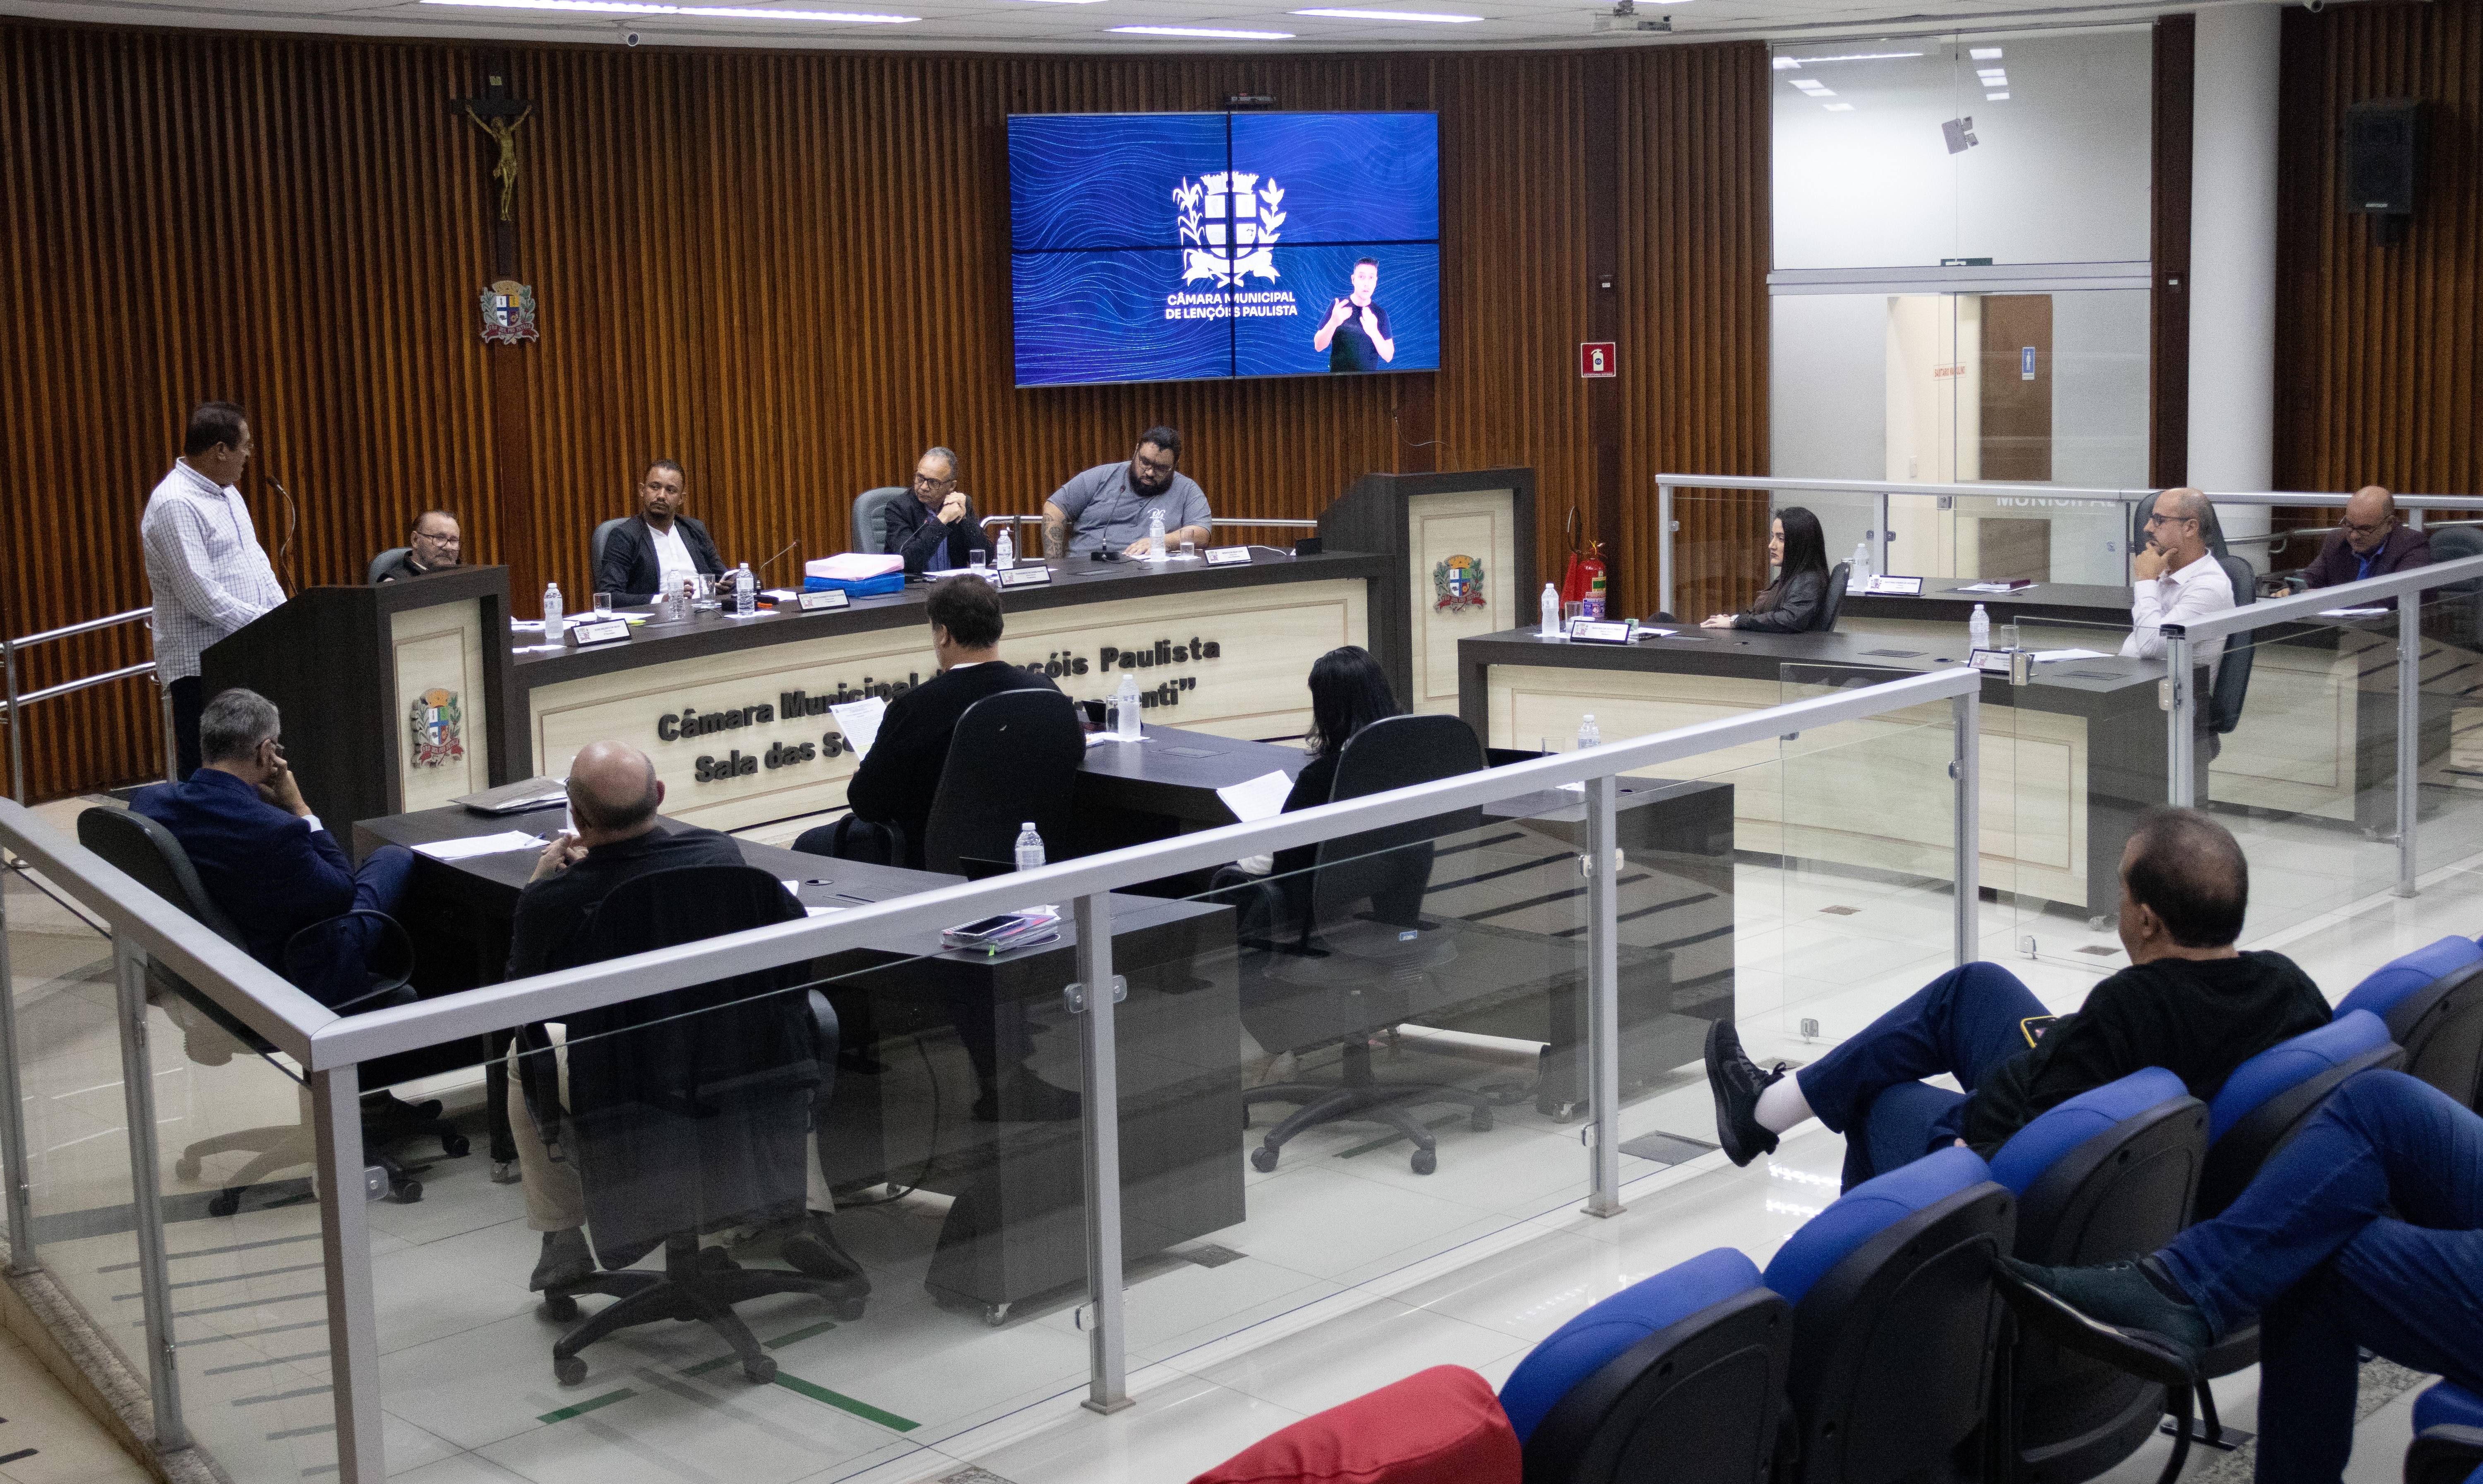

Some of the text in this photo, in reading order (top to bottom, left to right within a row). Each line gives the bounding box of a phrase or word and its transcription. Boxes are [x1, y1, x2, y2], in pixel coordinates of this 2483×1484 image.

[1167, 291, 1295, 305] CÂMARA MUNICIPAL
[1165, 305, 1298, 321] DE LENÇÓIS PAULISTA
[658, 708, 774, 742] Câmara
[1100, 636, 1220, 672] Paulista
[695, 750, 758, 783] Sala
[764, 741, 816, 770] das
